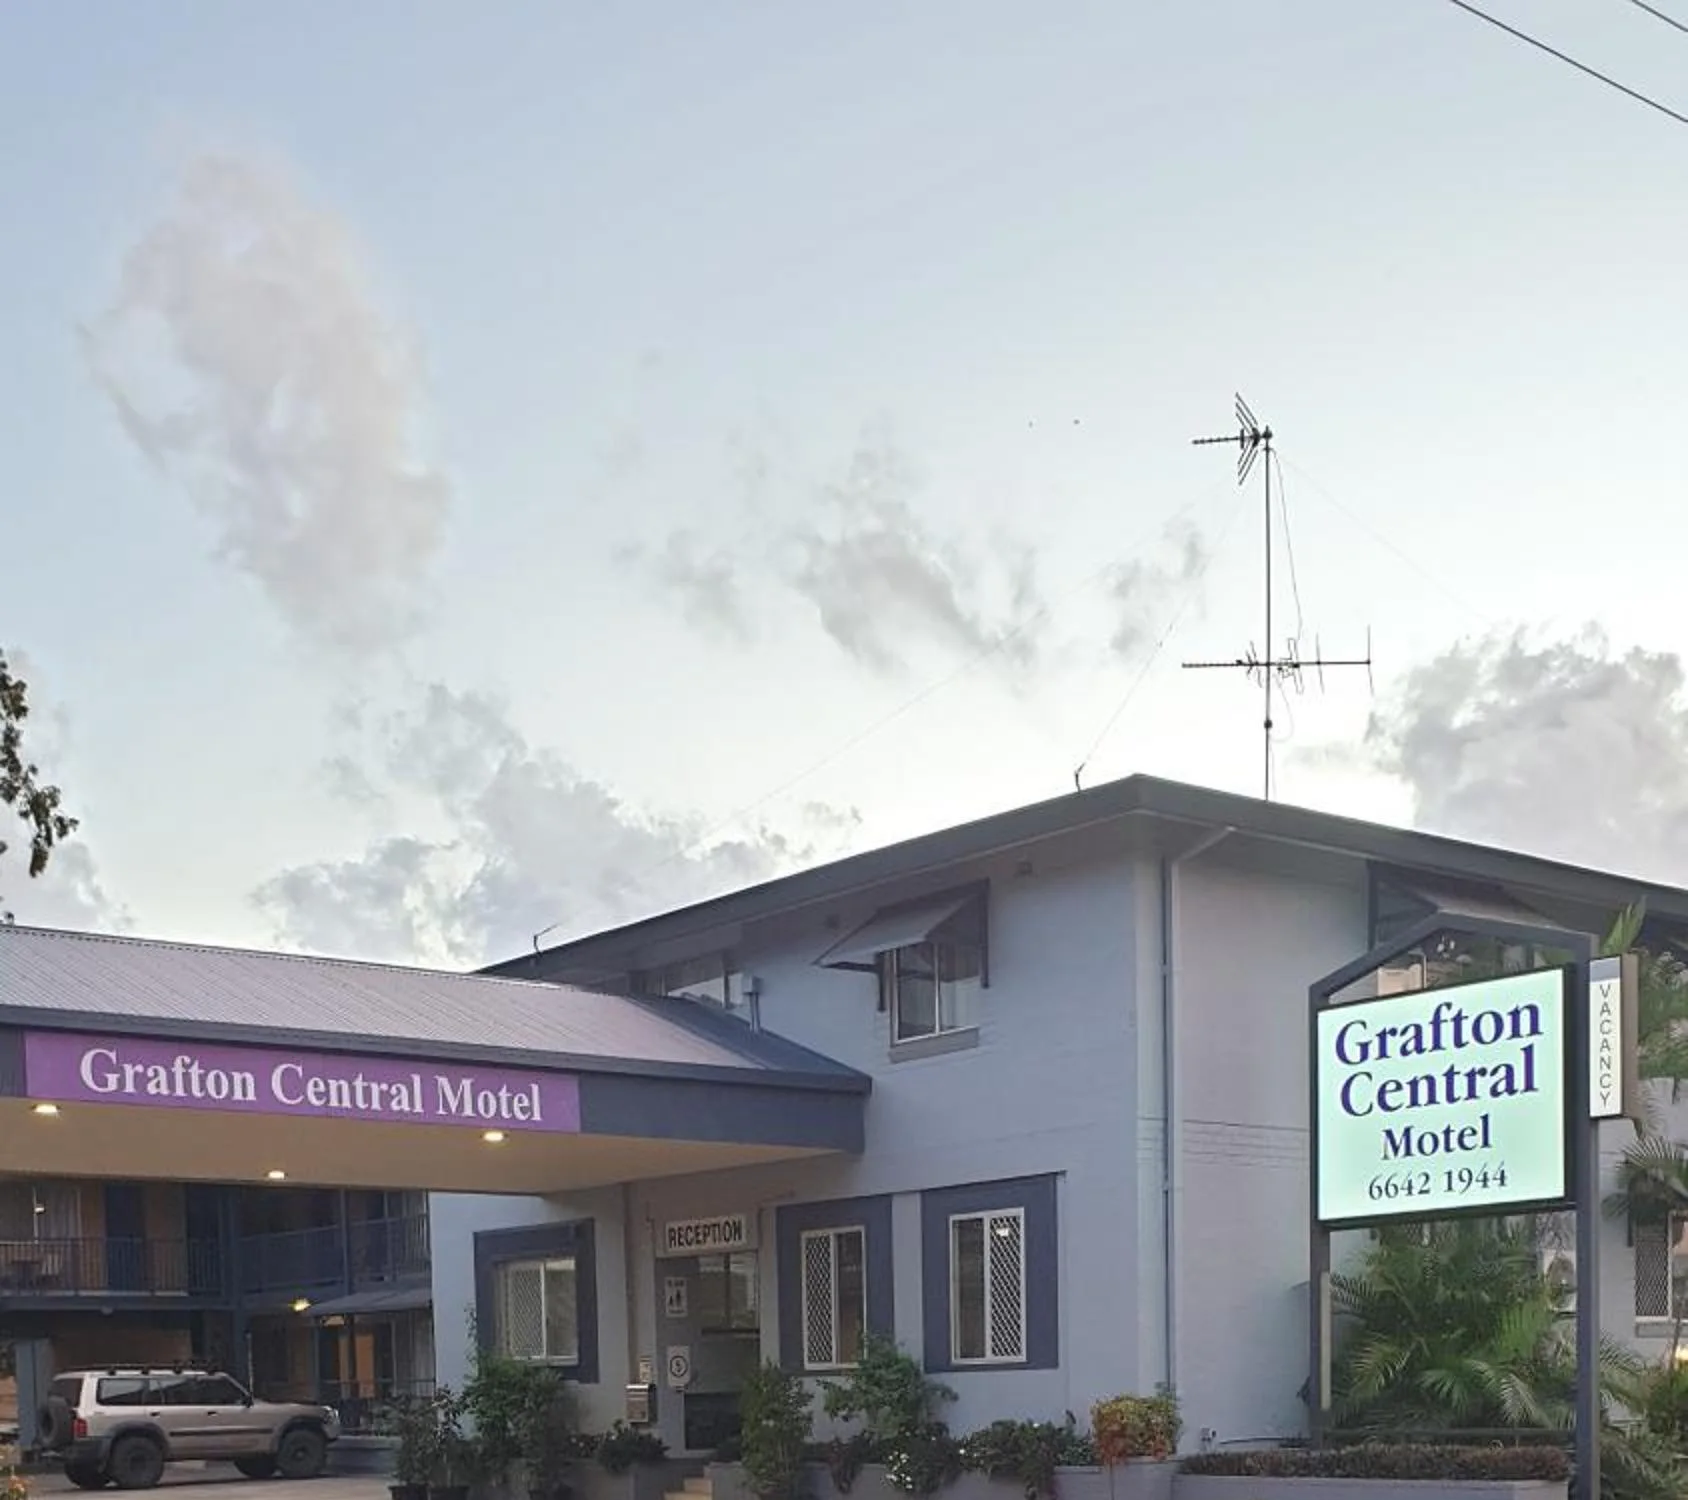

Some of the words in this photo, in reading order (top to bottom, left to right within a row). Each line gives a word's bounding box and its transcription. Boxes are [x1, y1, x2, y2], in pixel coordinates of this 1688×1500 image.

[1335, 1001, 1543, 1066] Grafton
[1599, 983, 1612, 1107] VACANCY
[80, 1048, 256, 1101] Grafton
[271, 1063, 425, 1113] Central
[433, 1074, 542, 1121] Motel
[1340, 1043, 1539, 1117] Central
[1381, 1113, 1493, 1161] Motel
[1368, 1171, 1431, 1200] 6642
[1443, 1160, 1507, 1194] 1944
[668, 1219, 743, 1248] RECEPTION
